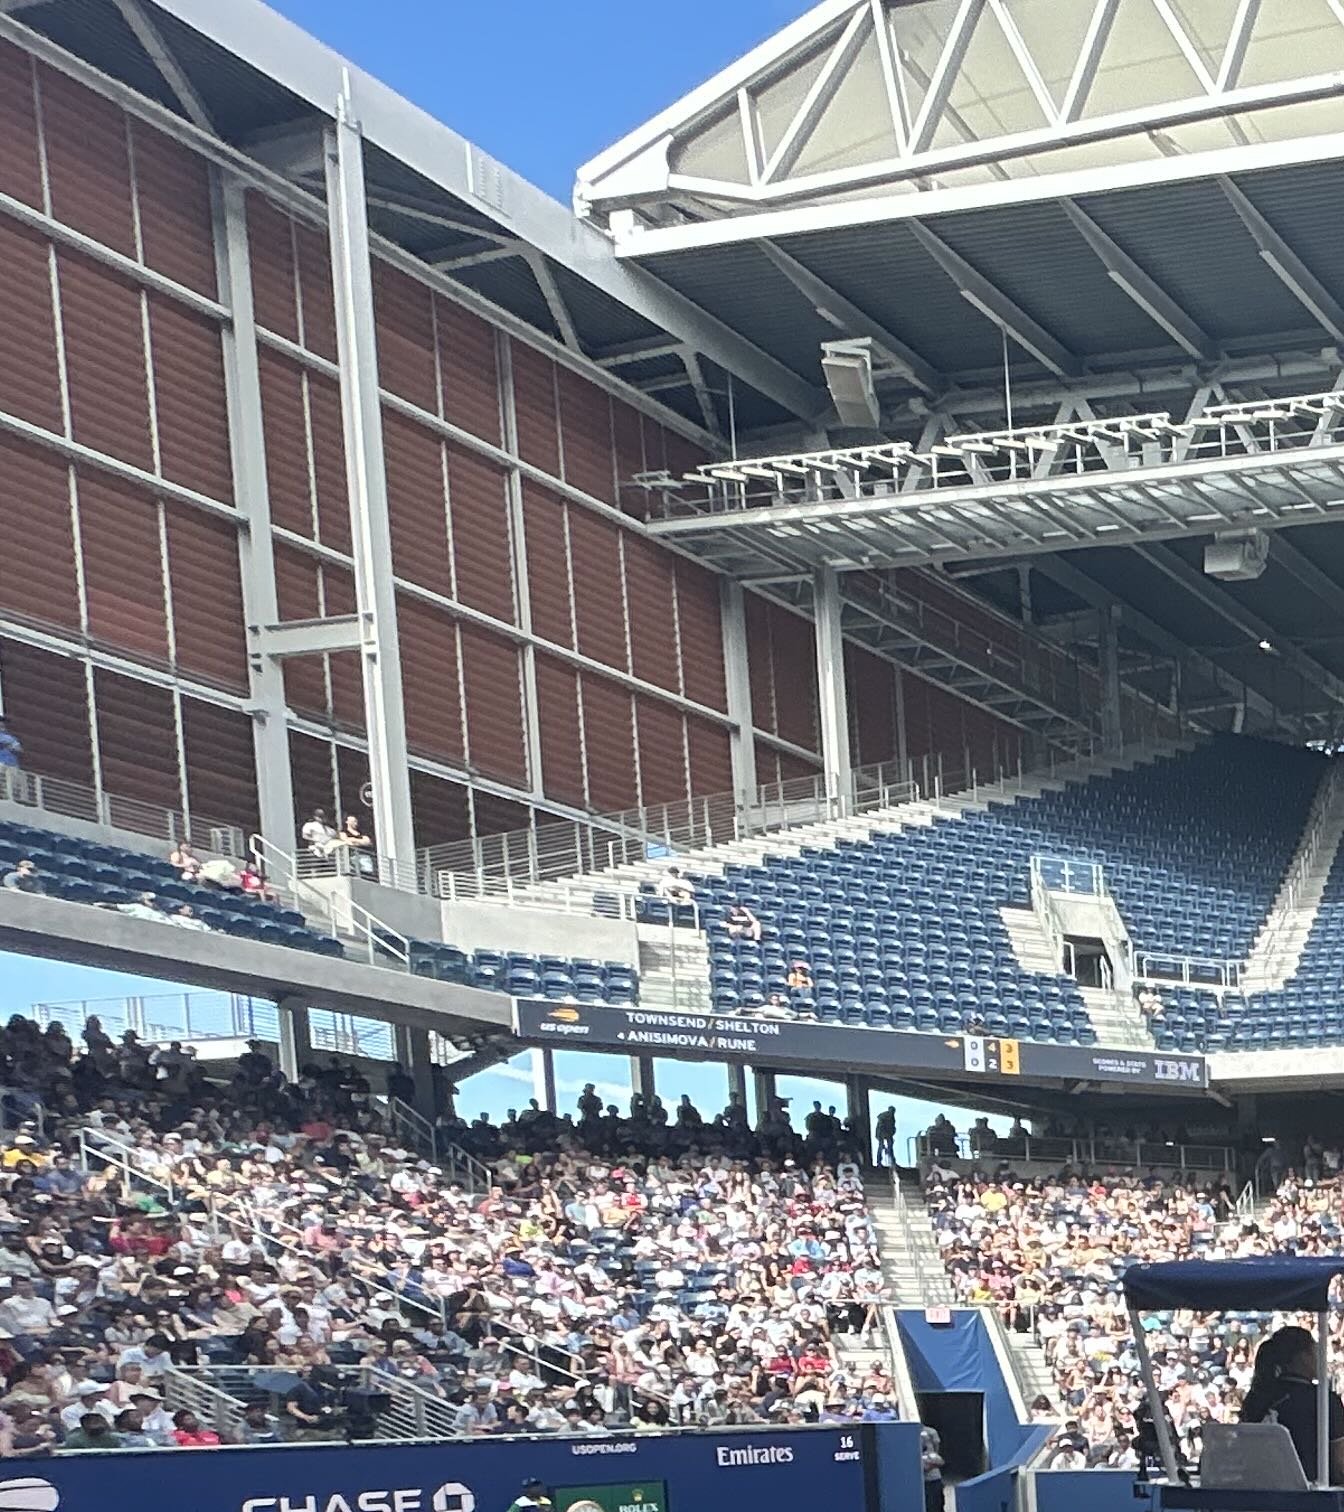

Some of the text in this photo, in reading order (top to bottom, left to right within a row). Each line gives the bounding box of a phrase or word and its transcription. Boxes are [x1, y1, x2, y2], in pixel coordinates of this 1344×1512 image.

[971, 1041, 1013, 1053] 0 4 3
[971, 1057, 1014, 1070] 0 2 3
[1154, 1060, 1200, 1081] IBM
[840, 1436, 853, 1449] 16
[717, 1445, 794, 1467] Emirates
